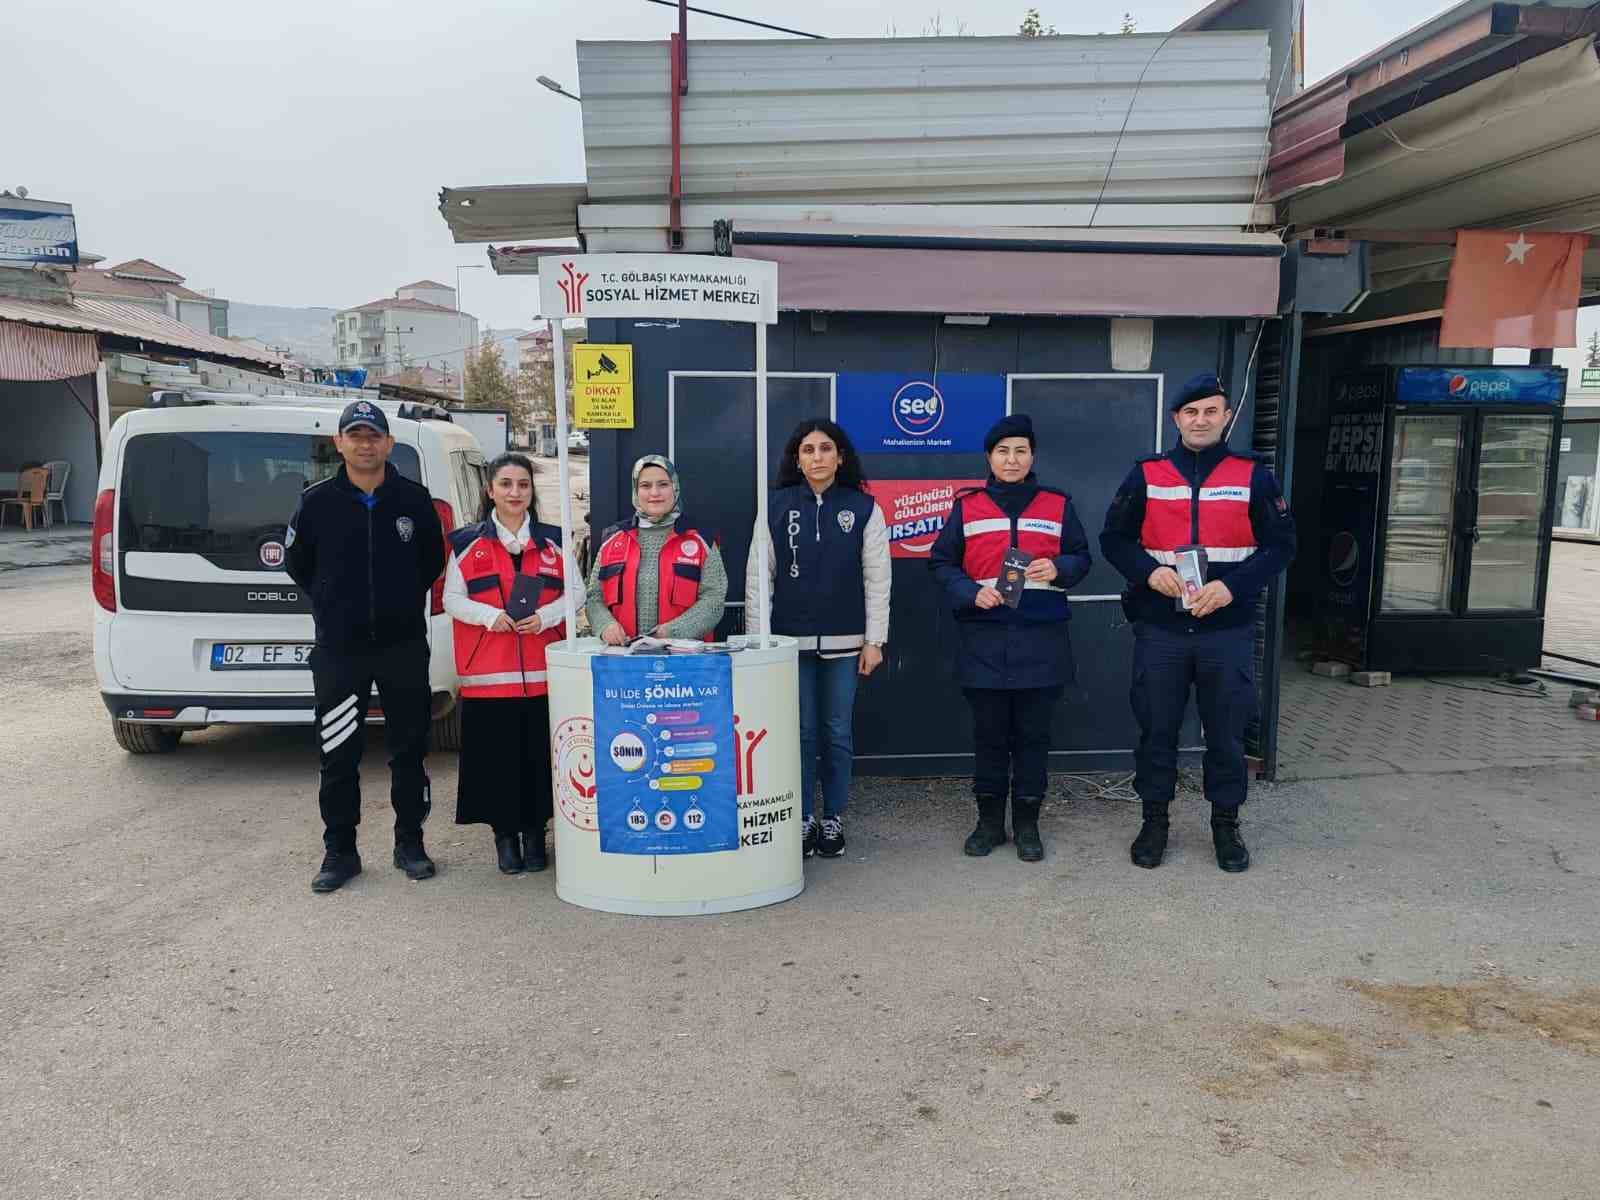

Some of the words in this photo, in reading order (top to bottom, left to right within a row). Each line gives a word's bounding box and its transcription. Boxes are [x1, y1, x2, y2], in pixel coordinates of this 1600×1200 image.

[601, 273, 618, 283] T.C.
[621, 271, 667, 284] GÖLBAŞI
[670, 272, 747, 286] KAYMAKAMLIĞI
[586, 288, 641, 302] SOSYAL
[645, 285, 699, 302] HİZMET
[703, 289, 760, 305] MERKEZİ
[1470, 379, 1511, 394] pepsi
[894, 485, 953, 508] YÜZÜNÜZÜ
[894, 500, 953, 521] GÜLDÜREN
[265, 548, 281, 561] FIAT
[248, 592, 298, 601] DOBLO
[224, 646, 244, 663] 02
[262, 646, 284, 663] EF
[605, 688, 618, 698] BU
[644, 684, 694, 702] ŞÖNİM
[698, 686, 720, 697] VAR
[688, 813, 702, 824] 112
[743, 806, 793, 828] HİZMET
